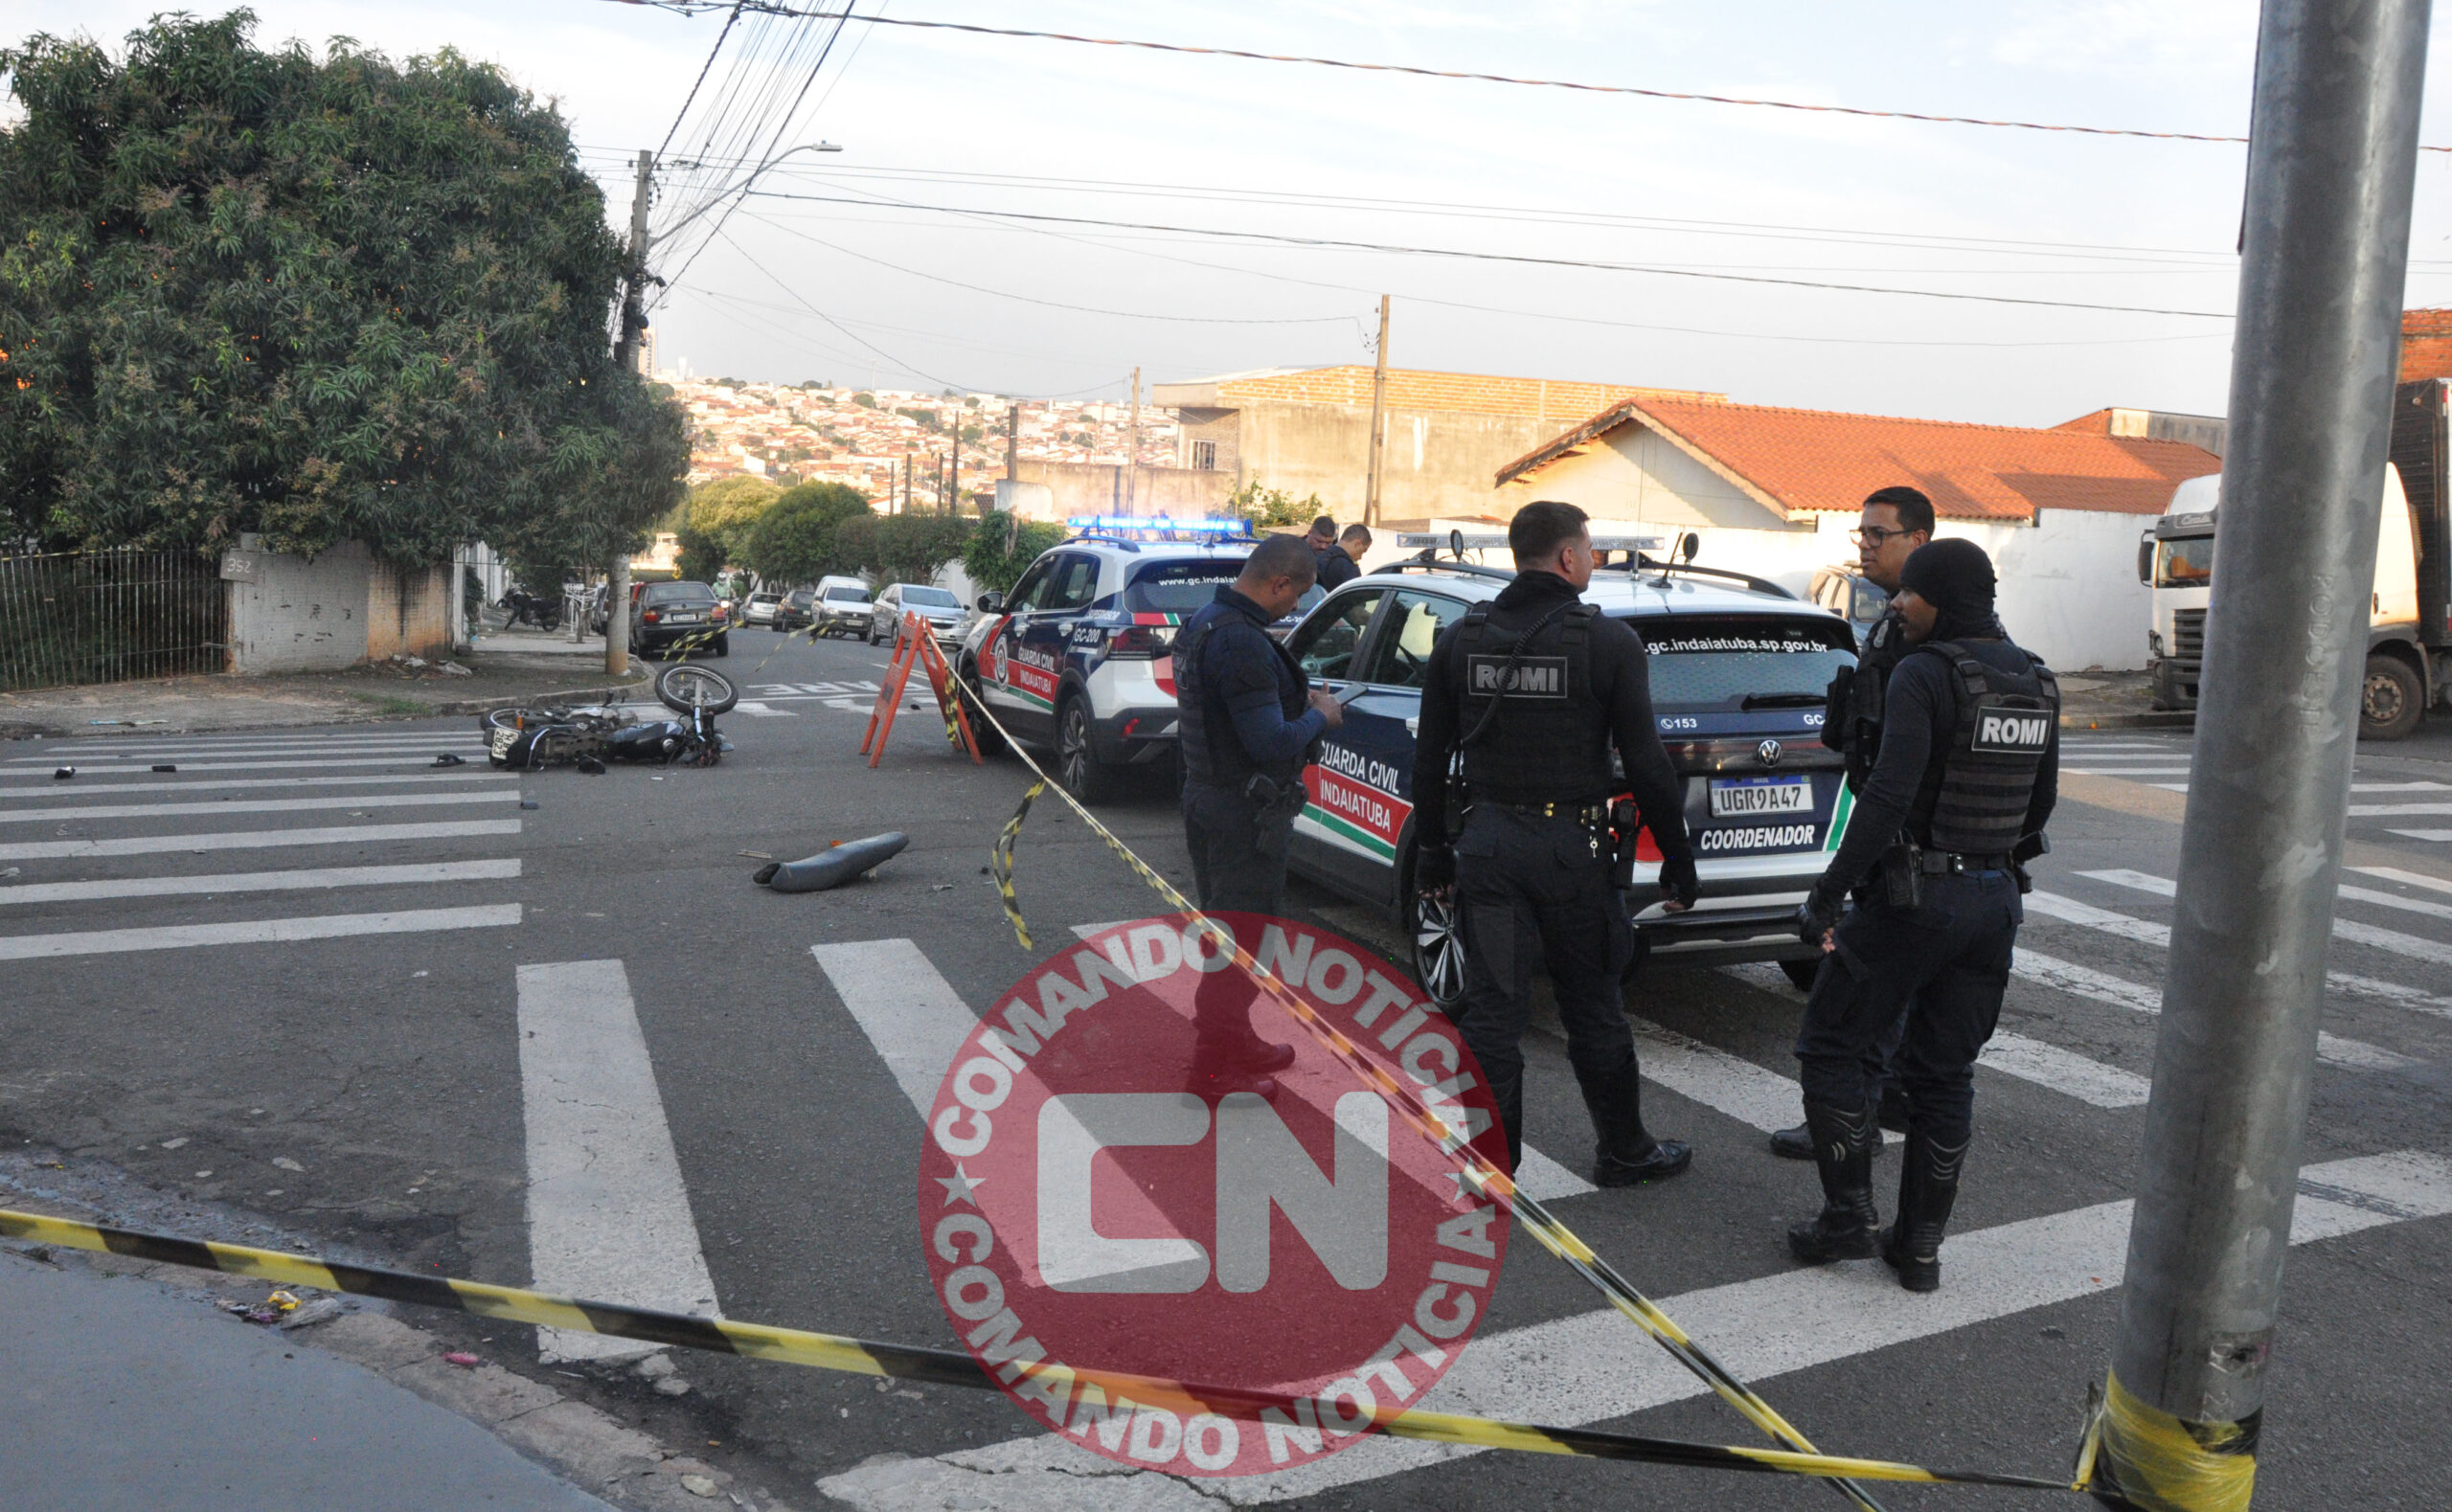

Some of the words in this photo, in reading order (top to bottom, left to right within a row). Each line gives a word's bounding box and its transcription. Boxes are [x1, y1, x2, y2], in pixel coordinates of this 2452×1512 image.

[227, 557, 251, 574] 352
[1074, 627, 1101, 643] GC-200
[1018, 646, 1040, 666] GUARDA
[1041, 654, 1055, 671] CIVIL
[1020, 670, 1052, 692] INDAIATUBA
[1476, 665, 1558, 691] ROMI
[1673, 718, 1697, 729] 153
[1981, 716, 2047, 745] ROMI
[1369, 760, 1399, 795] CIVIL
[1322, 779, 1392, 833] INDAIATUBA
[1720, 786, 1801, 812] UGR9A47
[1701, 824, 1815, 850] COORDENADOR
